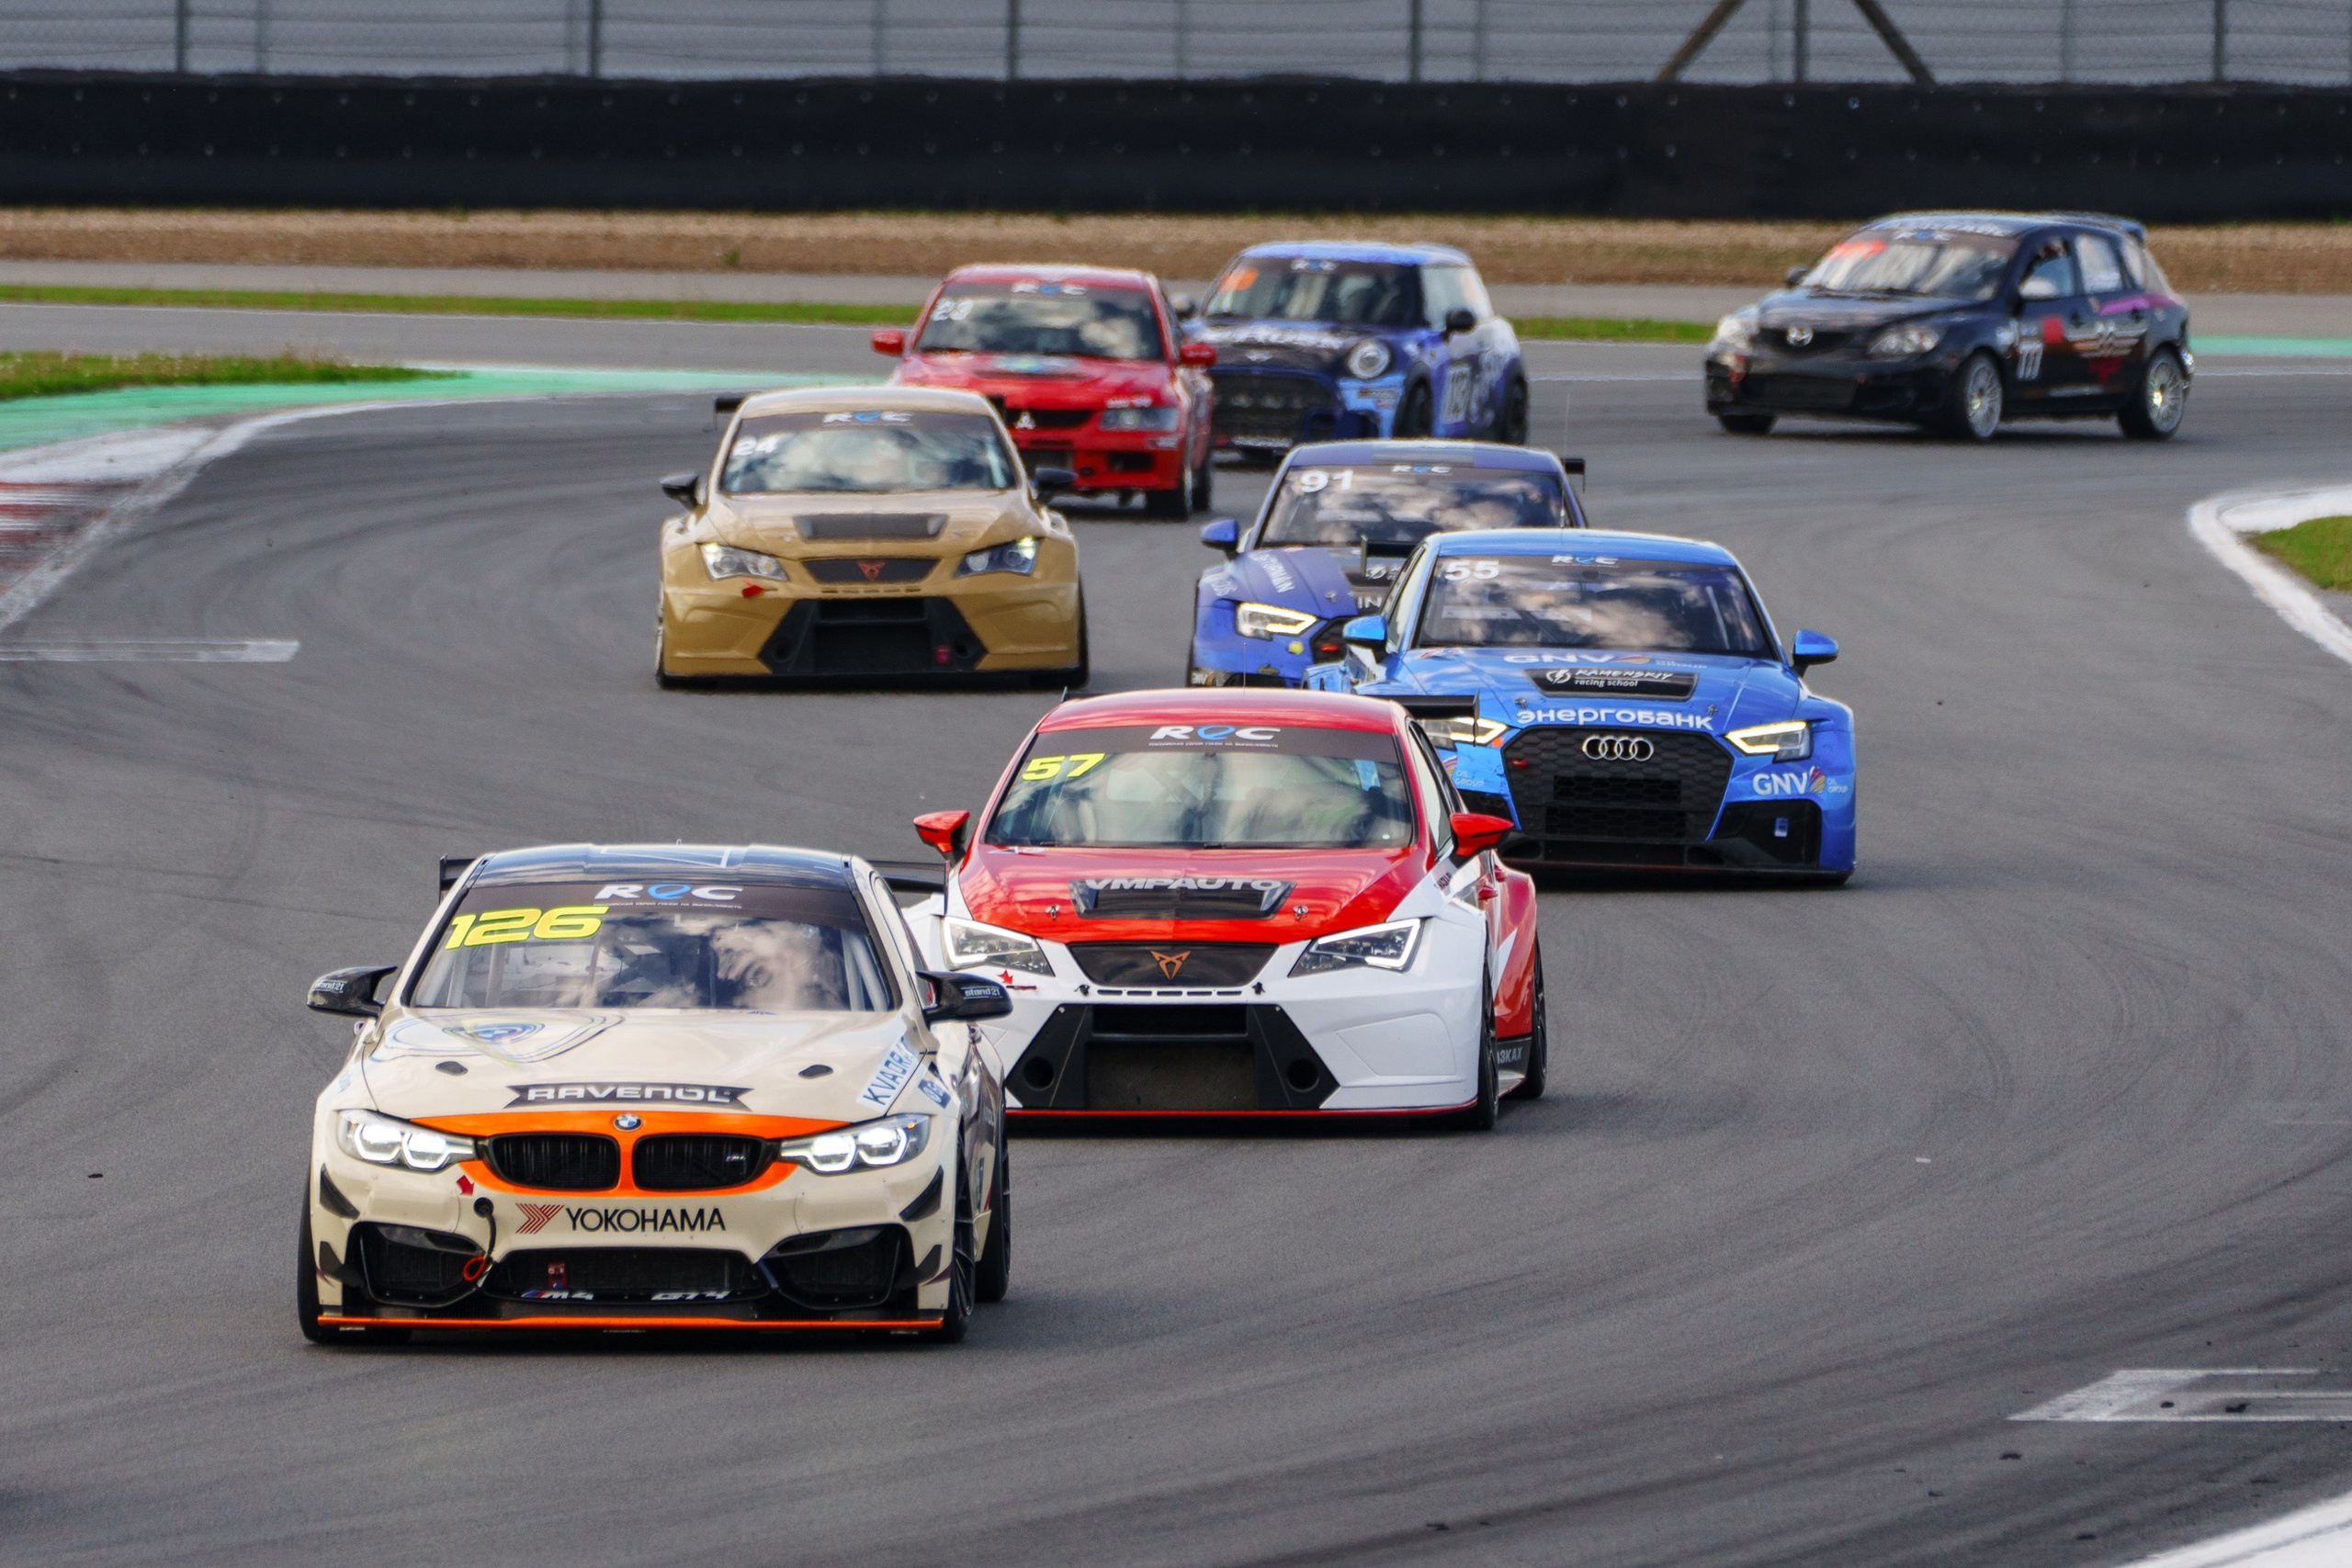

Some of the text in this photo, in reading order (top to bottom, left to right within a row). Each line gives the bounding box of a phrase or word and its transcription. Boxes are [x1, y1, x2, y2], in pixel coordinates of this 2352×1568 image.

[1301, 470, 1354, 492] 91
[1444, 560, 1499, 581] 55
[1503, 655, 1615, 664] GNV
[1574, 679, 1639, 688] racing school
[1022, 753, 1105, 781] 57
[1752, 773, 1808, 795] GNV
[1085, 878, 1282, 890] VMPAUTO
[445, 906, 610, 950] 126
[527, 1087, 731, 1103] RAVENOL
[566, 1208, 726, 1233] YOKOHAMA
